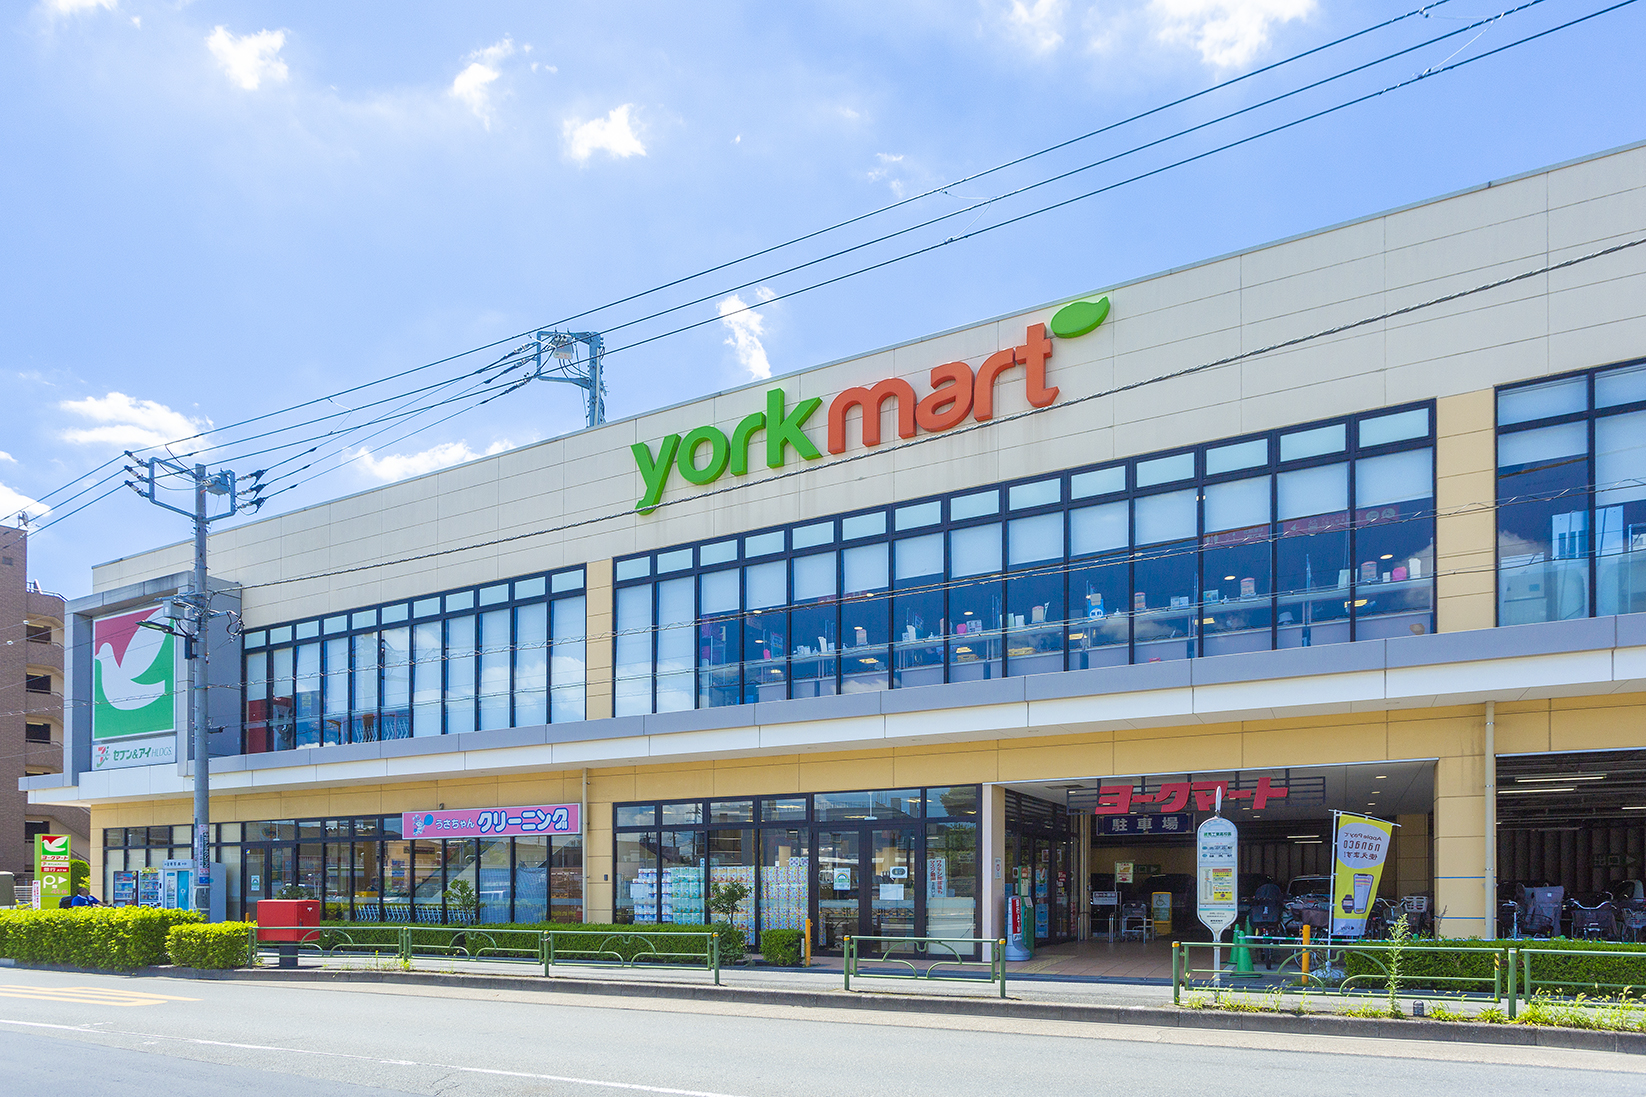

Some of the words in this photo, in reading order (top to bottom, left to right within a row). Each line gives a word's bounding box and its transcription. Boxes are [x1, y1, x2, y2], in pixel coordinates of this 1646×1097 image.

[1095, 777, 1288, 814] ヨークマート
[435, 818, 475, 830] うさちゃん
[477, 807, 569, 834] クリーニング
[1111, 817, 1179, 832] 駐車場
